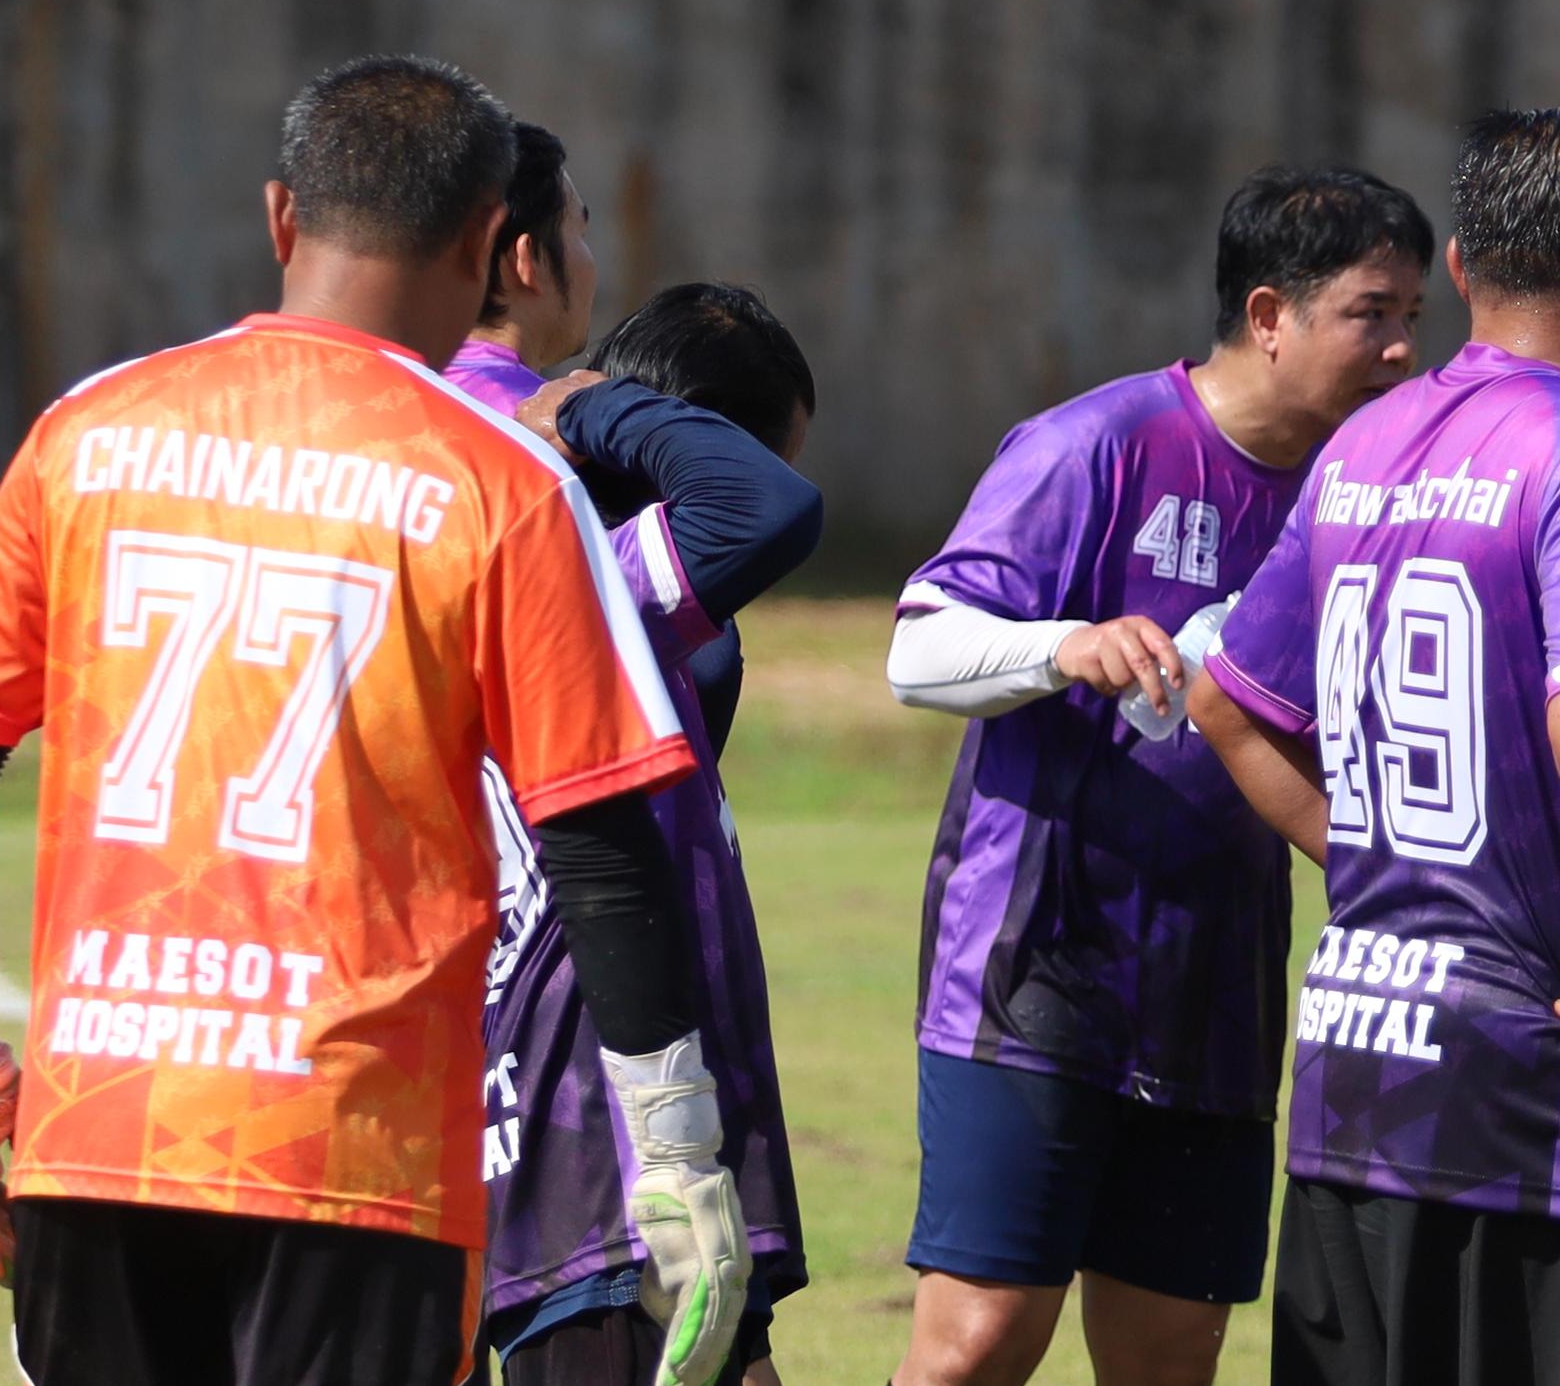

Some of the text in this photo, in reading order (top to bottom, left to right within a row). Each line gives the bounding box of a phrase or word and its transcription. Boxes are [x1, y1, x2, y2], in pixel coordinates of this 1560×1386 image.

[74, 425, 454, 545] CHAINARONG
[1133, 494, 1221, 588] 42
[96, 530, 394, 862] 77
[1316, 557, 1488, 865] 49
[67, 929, 324, 1007] MAESOT
[1307, 925, 1465, 993] AESOT
[50, 997, 313, 1076] HOSPITAL
